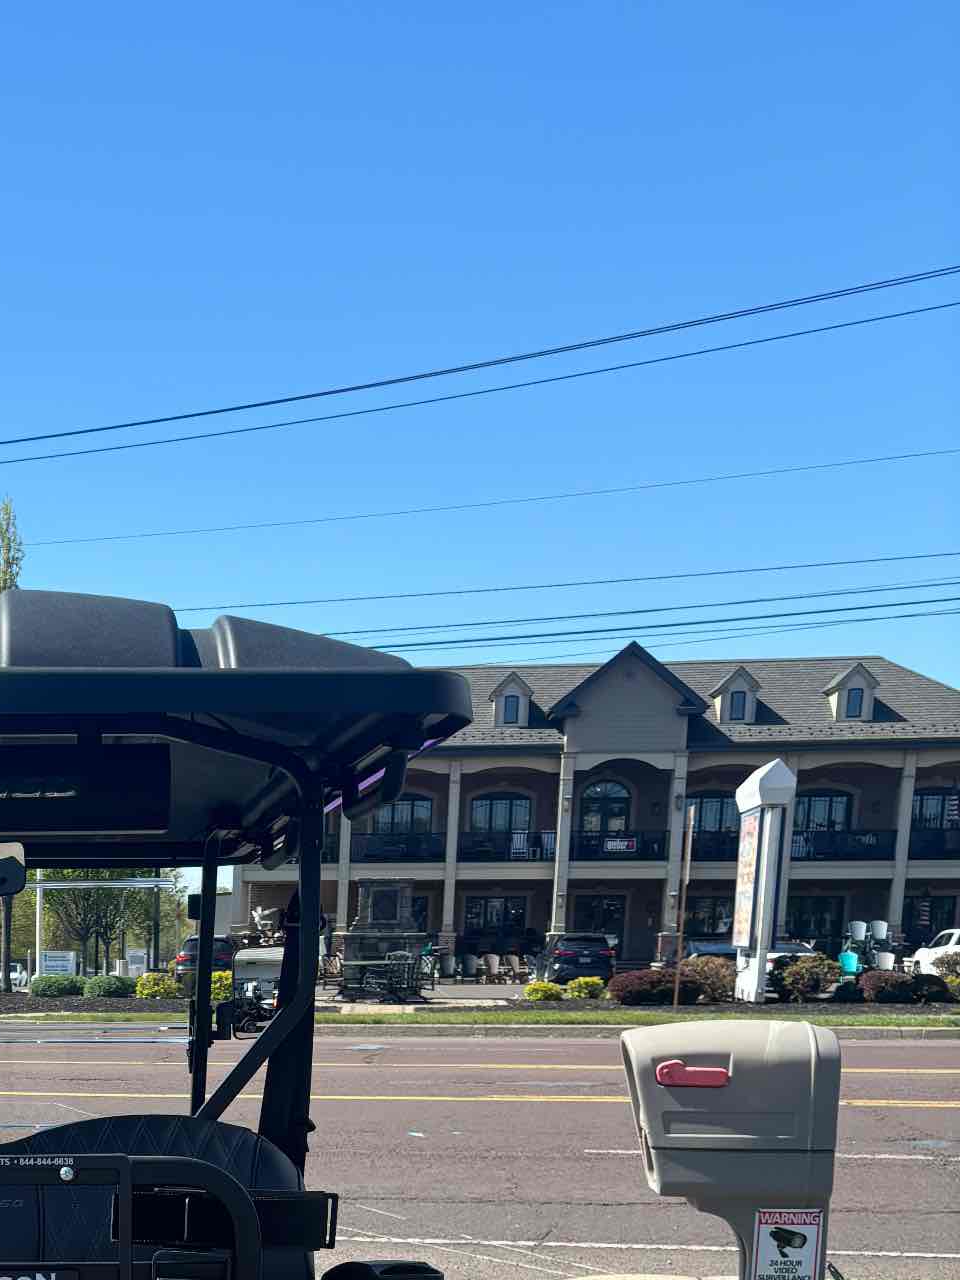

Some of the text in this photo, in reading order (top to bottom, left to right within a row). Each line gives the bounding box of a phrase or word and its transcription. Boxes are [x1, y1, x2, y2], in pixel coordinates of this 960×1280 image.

[760, 1212, 819, 1225] WARNING
[769, 1259, 802, 1267] 24 HOUR
